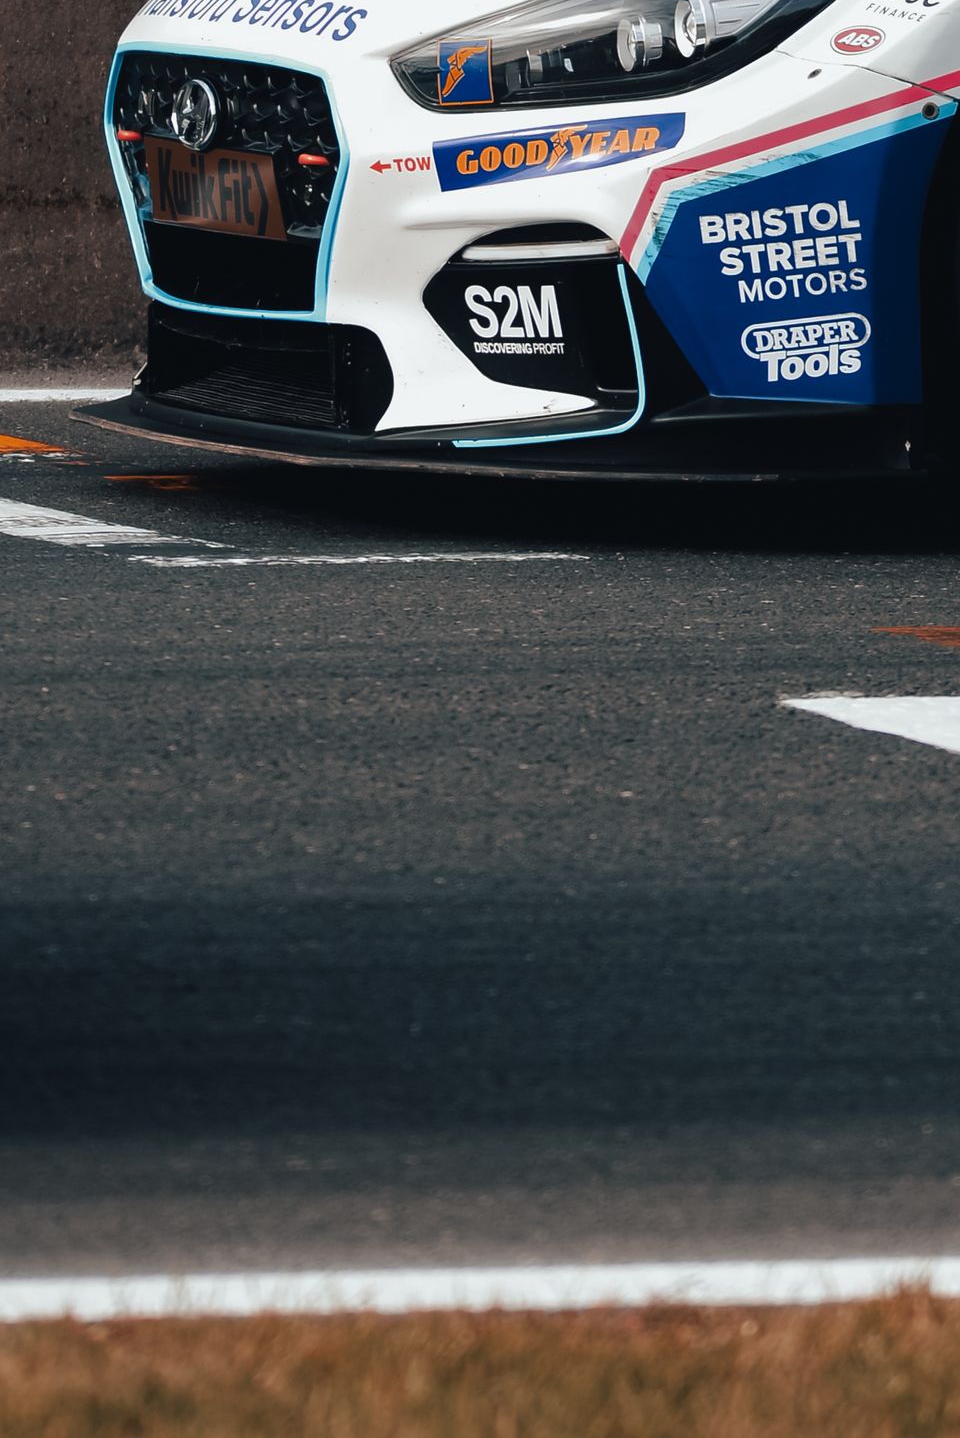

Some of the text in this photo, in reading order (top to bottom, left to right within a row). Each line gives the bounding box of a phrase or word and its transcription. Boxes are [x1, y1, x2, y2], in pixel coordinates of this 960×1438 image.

[866, 2, 927, 23] FINANCE
[837, 31, 881, 48] ABS
[393, 157, 431, 172] TOW
[699, 200, 860, 245] BRISTOL
[720, 233, 863, 276] STREET
[738, 268, 868, 303] MOTORS
[464, 285, 563, 338] S2M
[474, 341, 565, 355] DISCOVERING PROFIT
[753, 319, 859, 351] DRAPER
[760, 346, 862, 382] Tools
